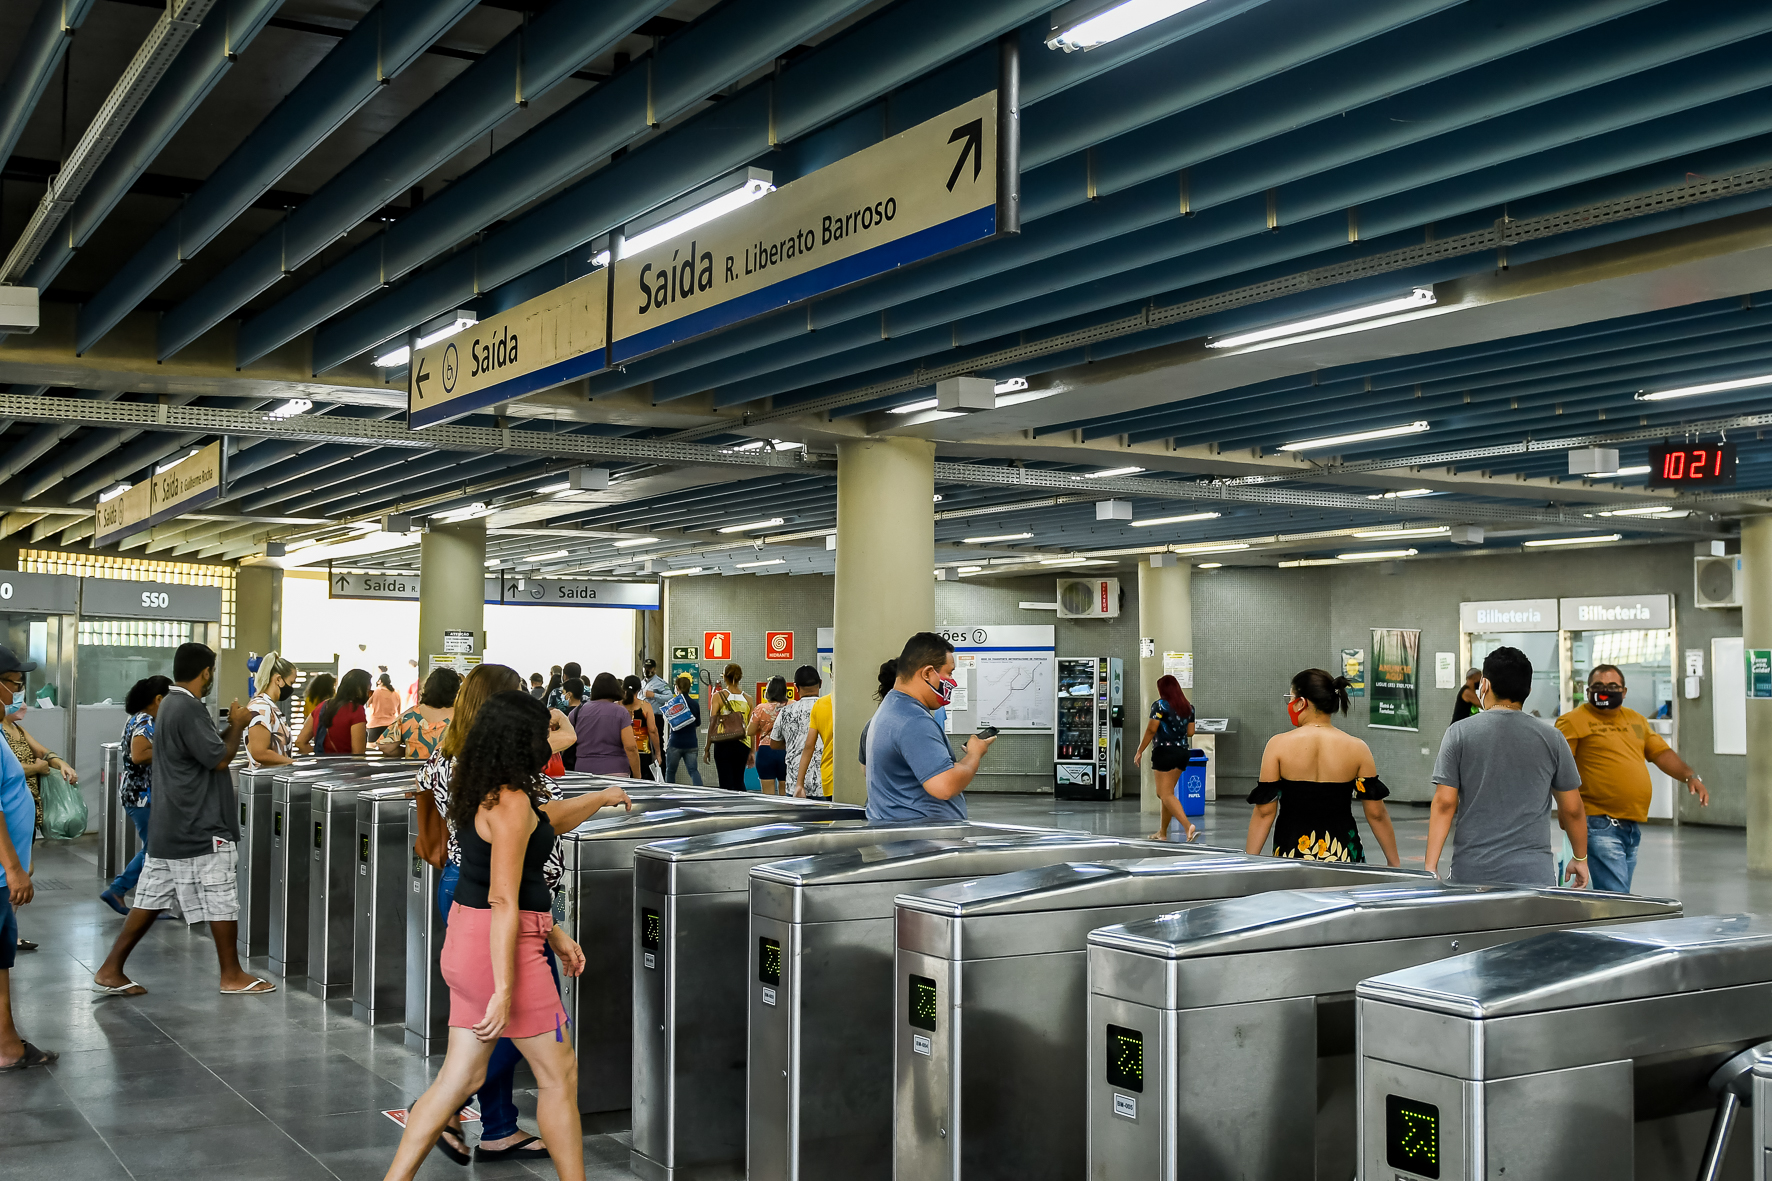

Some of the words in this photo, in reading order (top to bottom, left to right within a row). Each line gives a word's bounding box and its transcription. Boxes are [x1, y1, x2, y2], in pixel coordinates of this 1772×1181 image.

[638, 240, 714, 315] Saída
[724, 255, 739, 284] R.
[744, 228, 816, 276] Liberato
[821, 197, 897, 246] Barroso
[471, 325, 519, 378] Saída
[162, 471, 179, 502] Saída
[202, 466, 213, 482] Rocha
[103, 504, 117, 528] Saída
[363, 578, 406, 592] Saída
[411, 585, 418, 593] R.
[558, 585, 597, 600] Saída
[1477, 608, 1541, 624] Bilheteria
[1578, 603, 1650, 621] Bilheteria
[937, 629, 967, 642] ões
